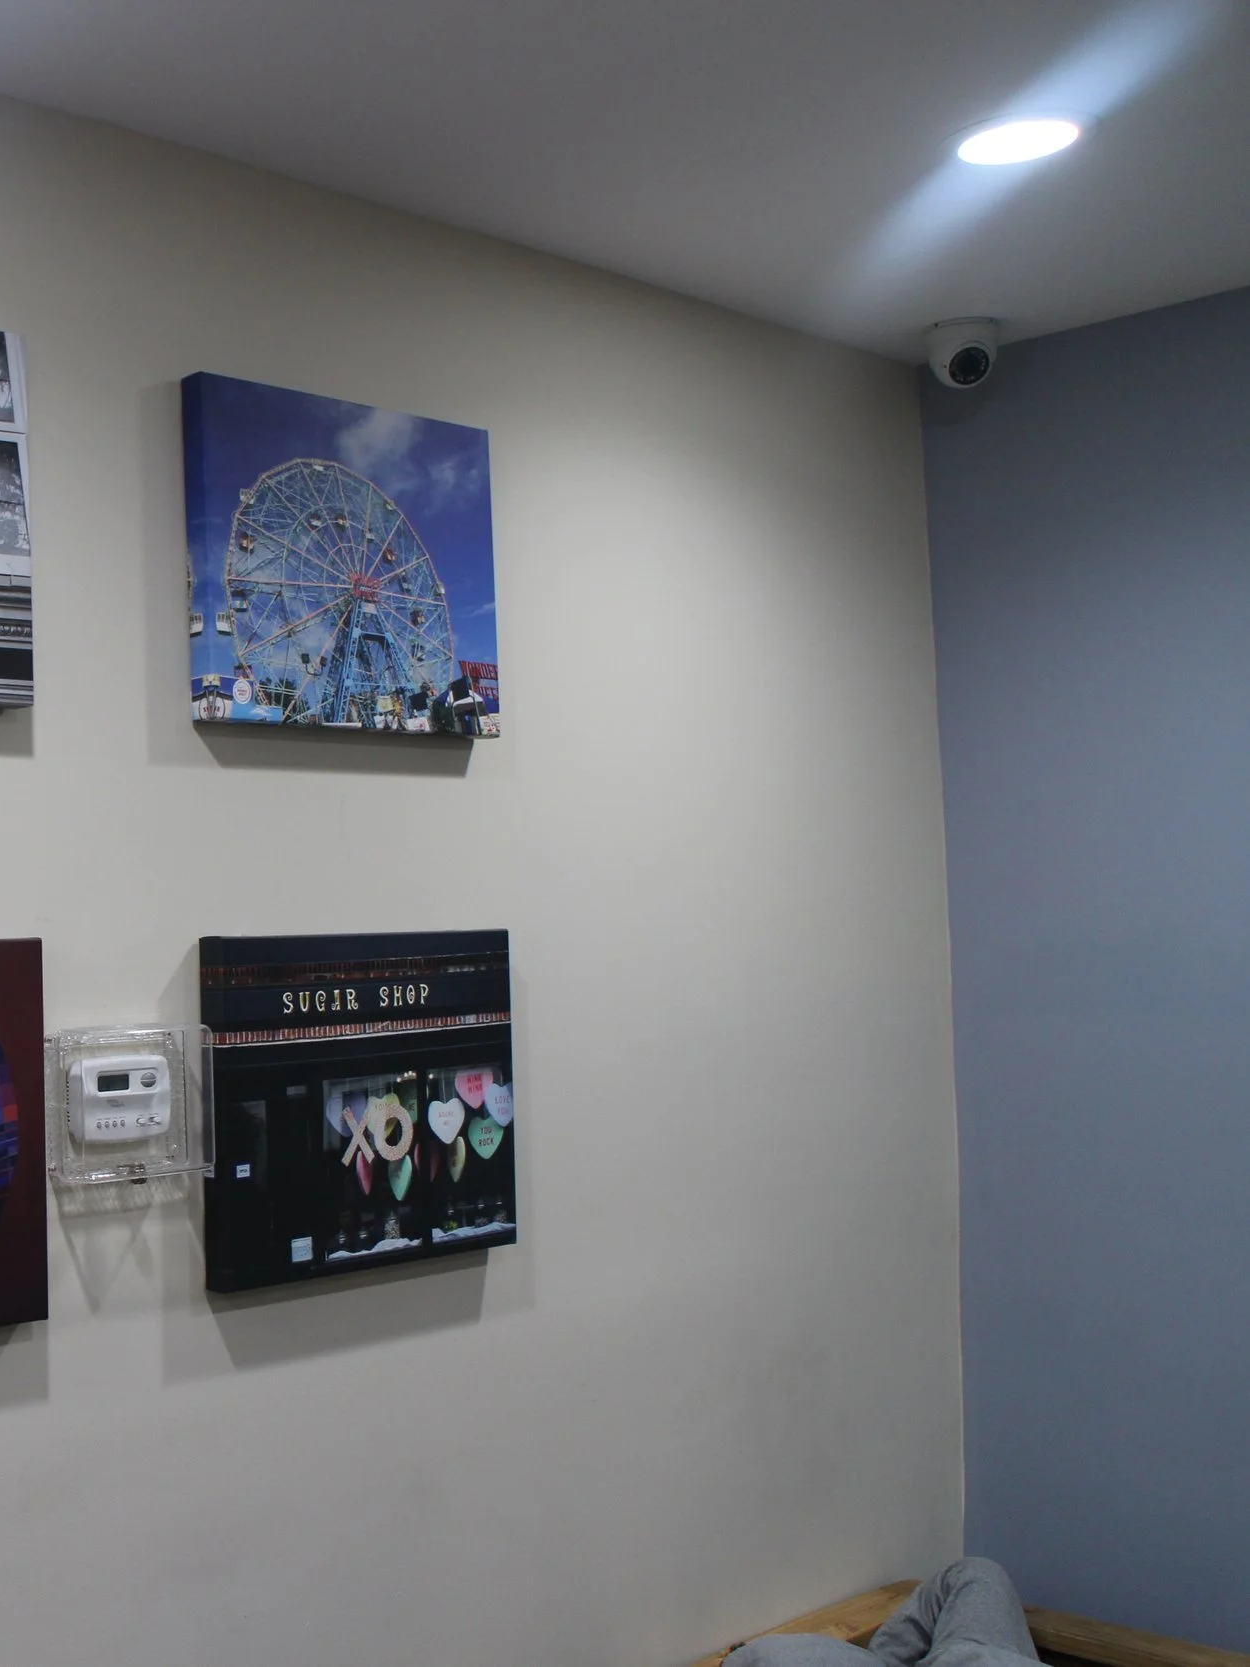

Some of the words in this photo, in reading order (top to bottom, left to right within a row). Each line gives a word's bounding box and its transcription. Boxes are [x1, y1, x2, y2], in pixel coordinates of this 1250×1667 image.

[282, 989, 359, 1014] SUGAR
[379, 983, 430, 1008] SHOP
[480, 1126, 493, 1135] YOU
[478, 1137, 494, 1147] ROCK
